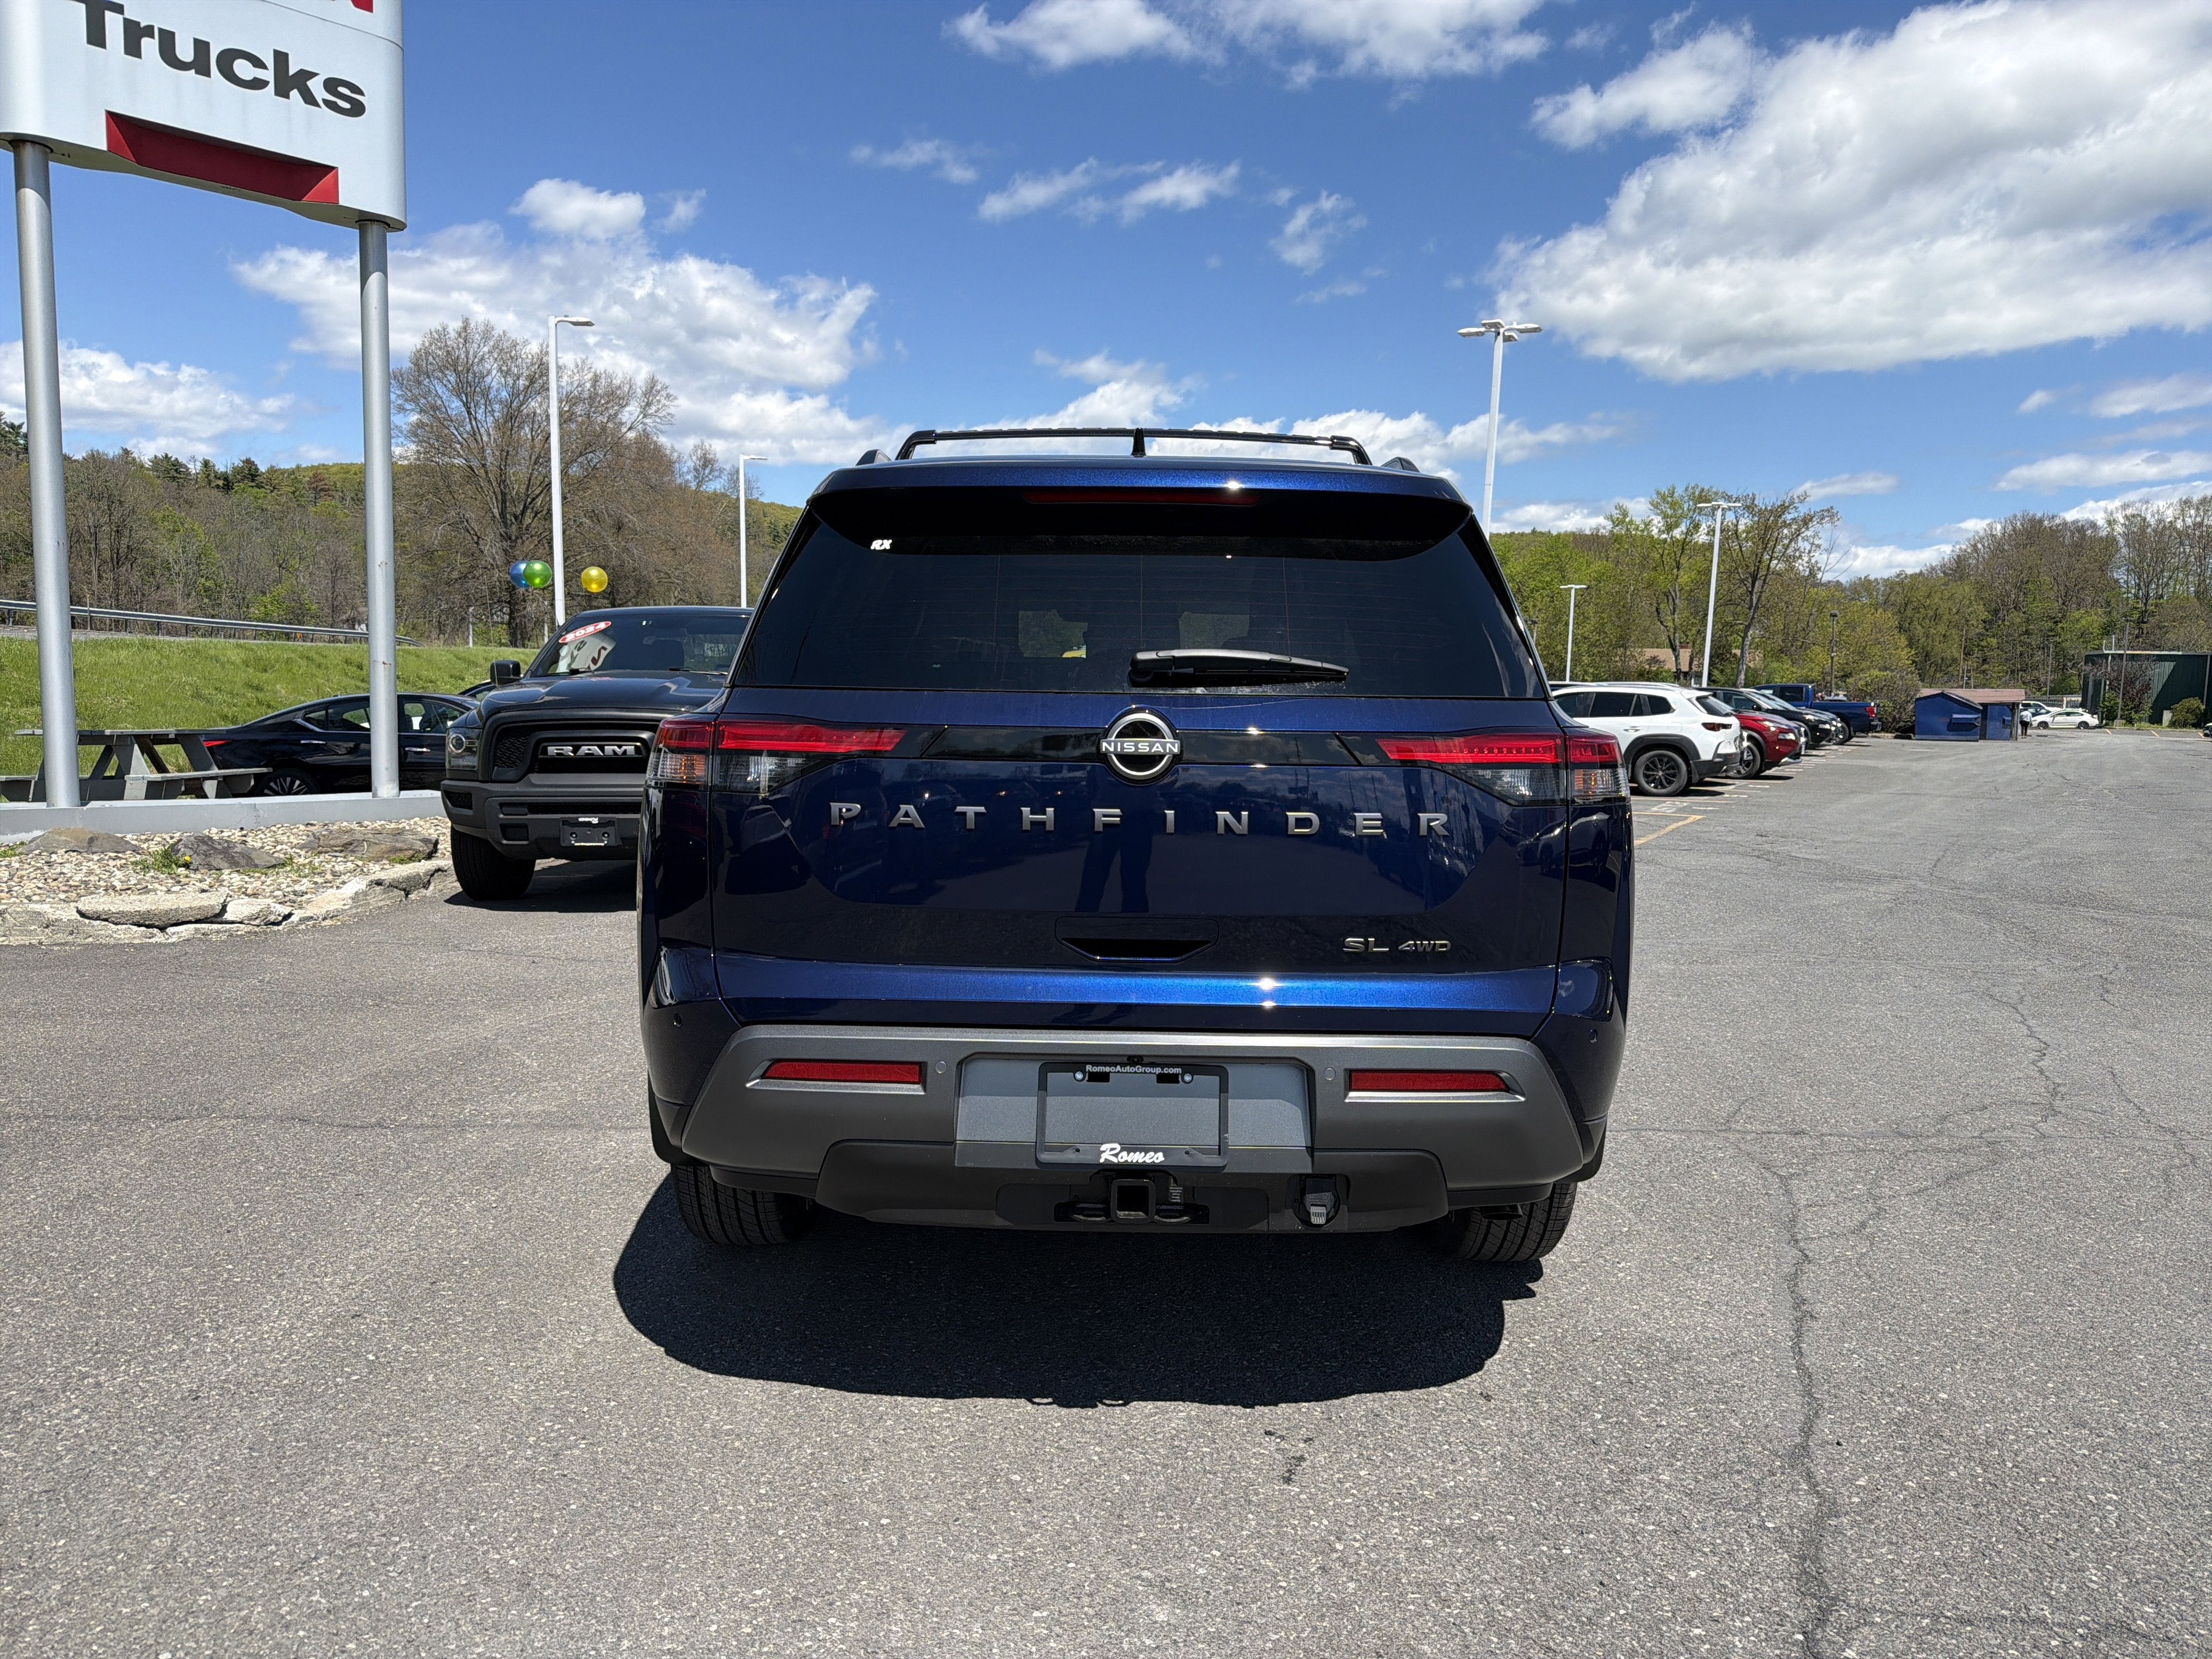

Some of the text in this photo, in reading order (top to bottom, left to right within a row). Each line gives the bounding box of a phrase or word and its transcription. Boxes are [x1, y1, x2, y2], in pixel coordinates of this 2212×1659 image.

[71, 0, 366, 118] Trucks
[566, 622, 606, 641] 2024
[547, 746, 636, 756] RAM
[1102, 742, 1178, 753] NISSAN
[829, 802, 1450, 837] PATHFINDER
[1342, 938, 1452, 952] SL 4WD
[1086, 1064, 1182, 1075] RomeoAutoGroup.com
[1099, 1143, 1165, 1164] Romeo
